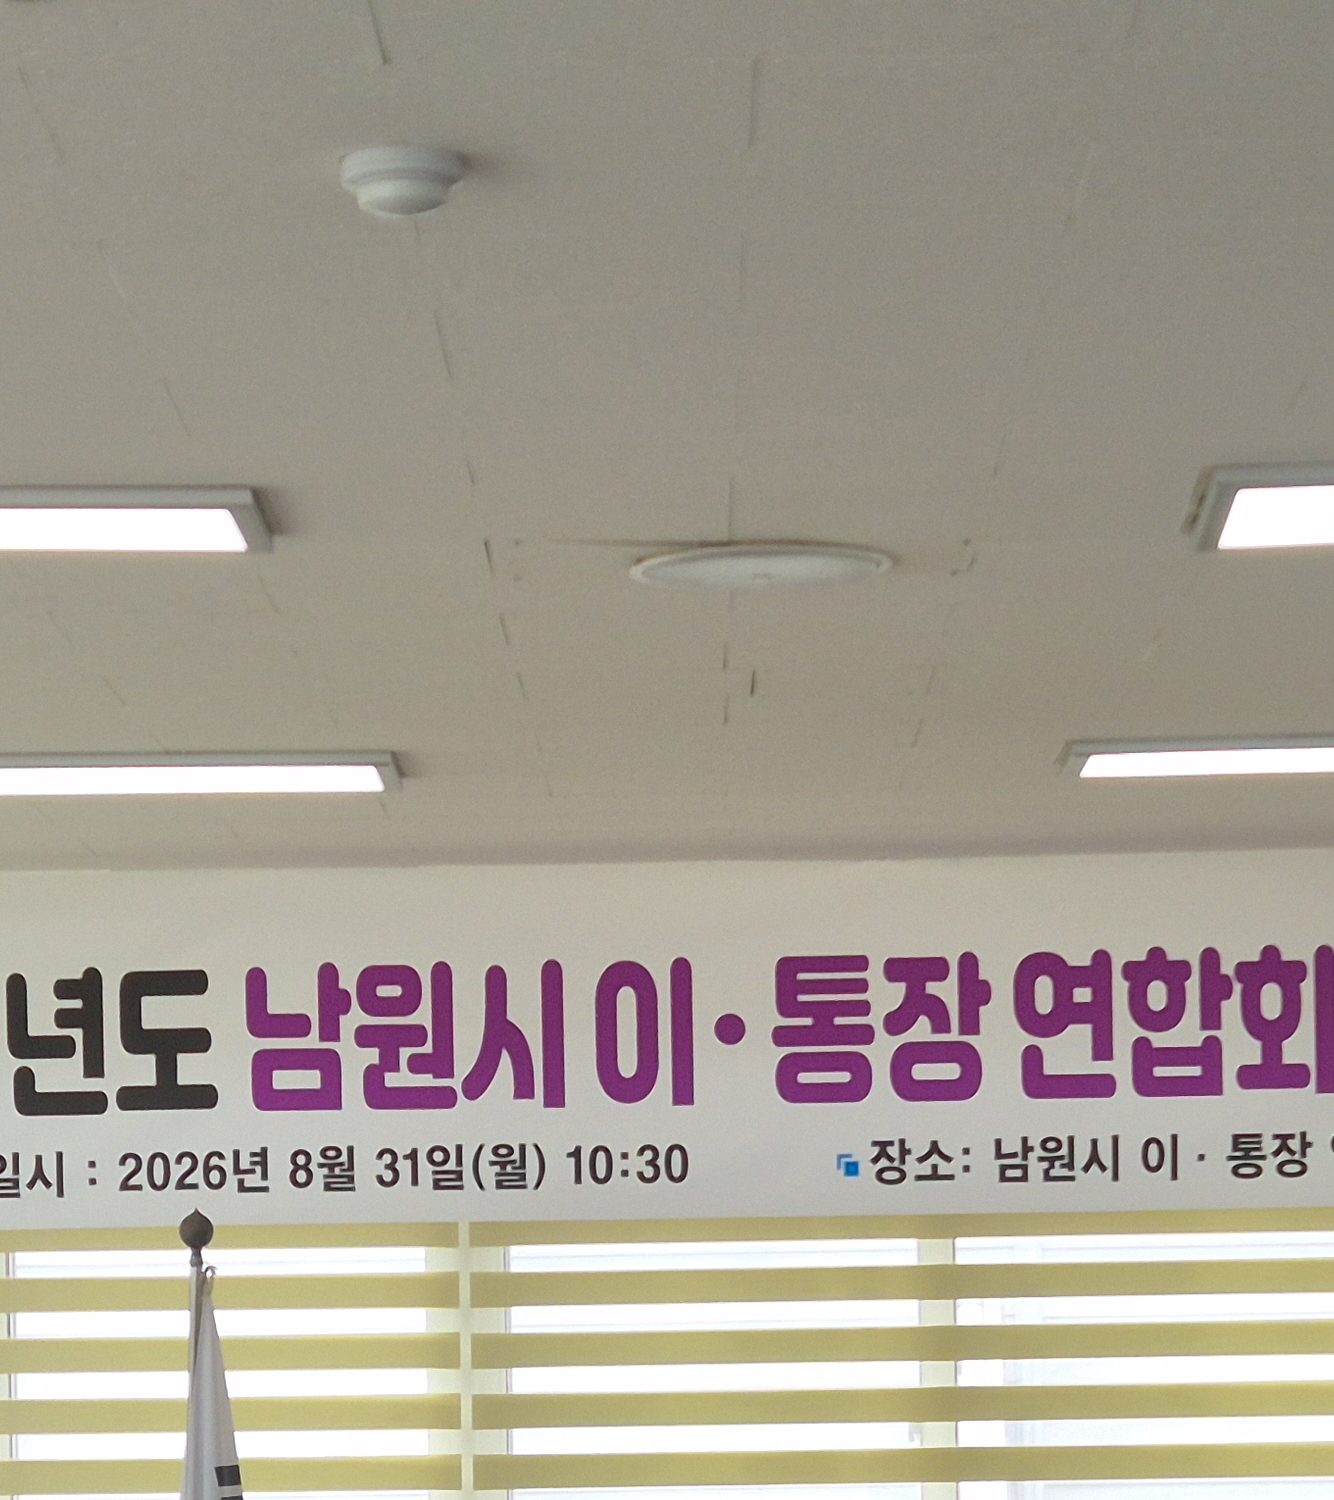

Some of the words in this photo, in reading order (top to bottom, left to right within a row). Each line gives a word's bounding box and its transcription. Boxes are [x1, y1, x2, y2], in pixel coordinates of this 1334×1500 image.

[246, 959, 565, 1111] 남원시
[118, 1147, 270, 1193] 2026년
[289, 1145, 356, 1192] 8월
[375, 1142, 546, 1191] 31일(월)
[566, 1143, 689, 1186] 10:30
[869, 1138, 971, 1186] 장소:
[994, 1134, 1120, 1183] 남원시
